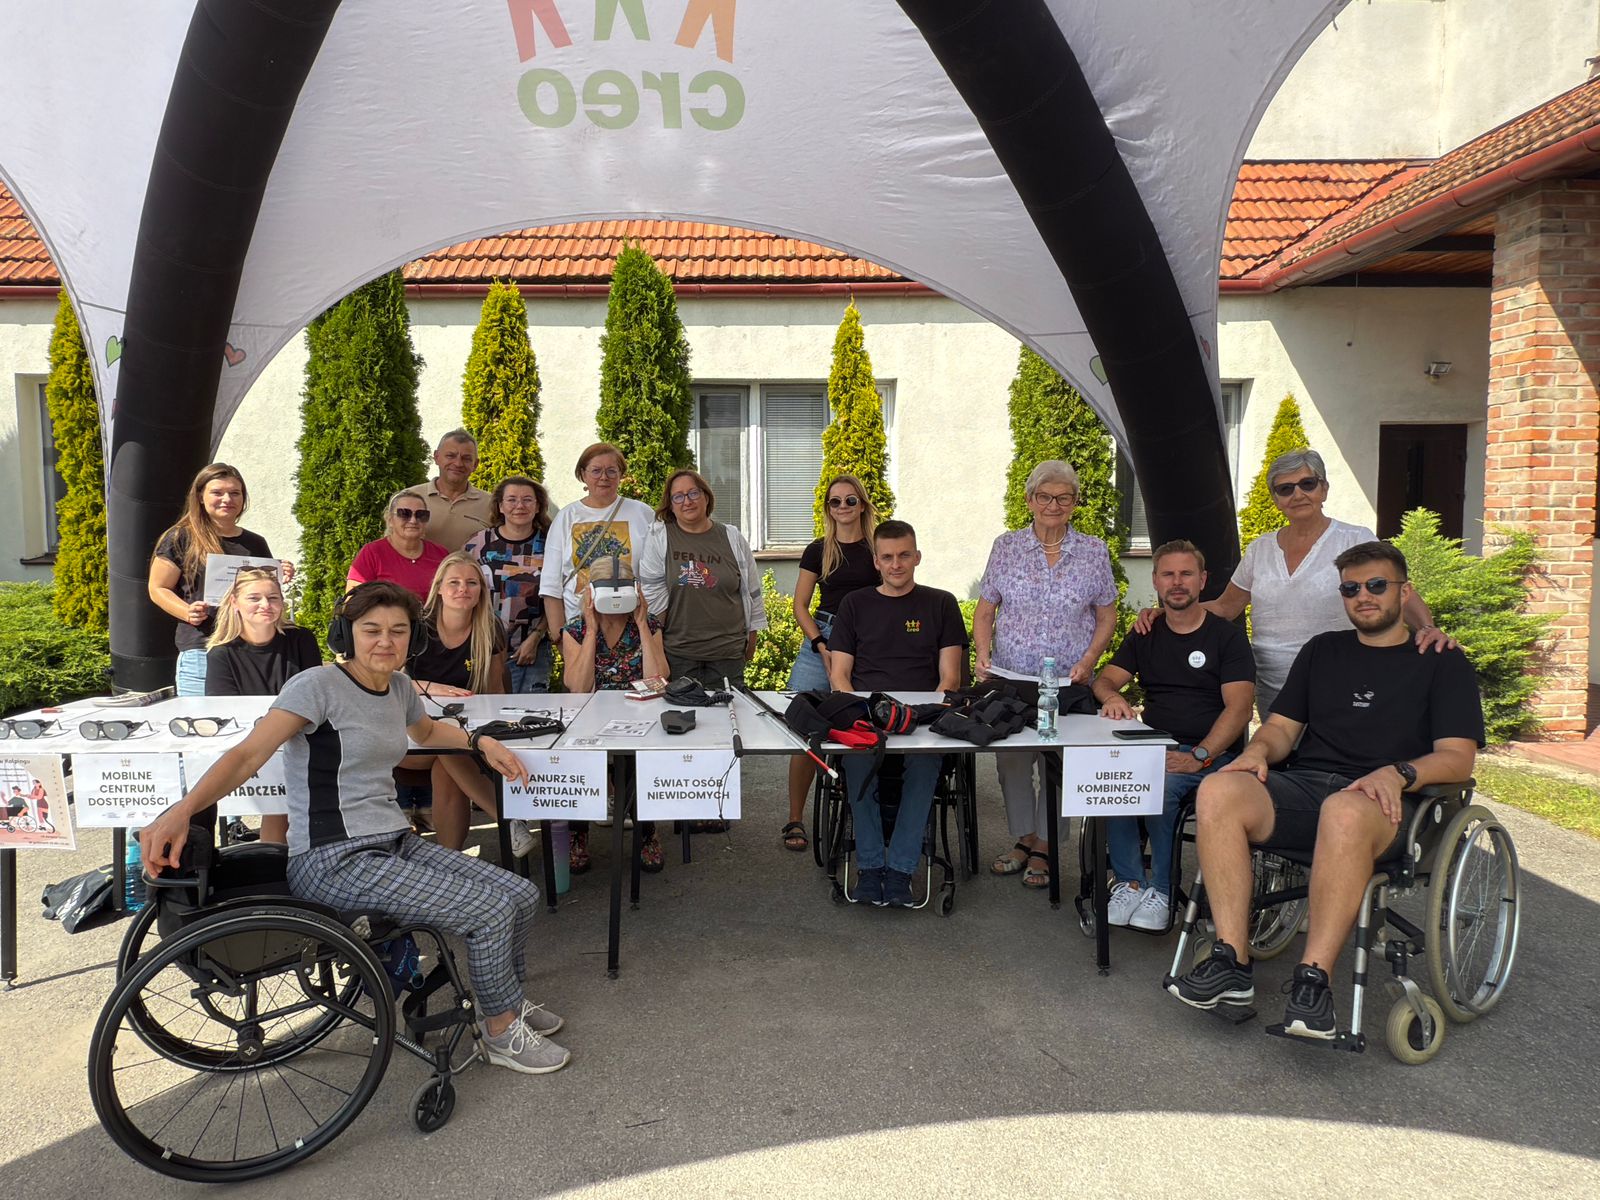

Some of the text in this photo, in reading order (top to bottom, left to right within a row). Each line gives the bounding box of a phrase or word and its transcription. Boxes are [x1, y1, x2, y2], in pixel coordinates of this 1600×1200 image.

[673, 551, 721, 564] BERLIN
[102, 771, 152, 780] MOBILNE
[529, 774, 586, 786] ANURZ SIĘ
[1095, 771, 1133, 780] UBIERZ
[653, 776, 723, 788] ŚWIAT OSÓB
[99, 784, 156, 793] CENTRUM
[510, 786, 600, 796] W WIRTUALNYM
[1077, 783, 1151, 793] KOMBINEZON
[647, 791, 730, 800] NIEWIDOMYCH
[1086, 793, 1141, 805] STAROŚCI
[88, 795, 169, 808] DOSTĘPNOŚCI
[532, 796, 578, 808] ŚWIECIE
